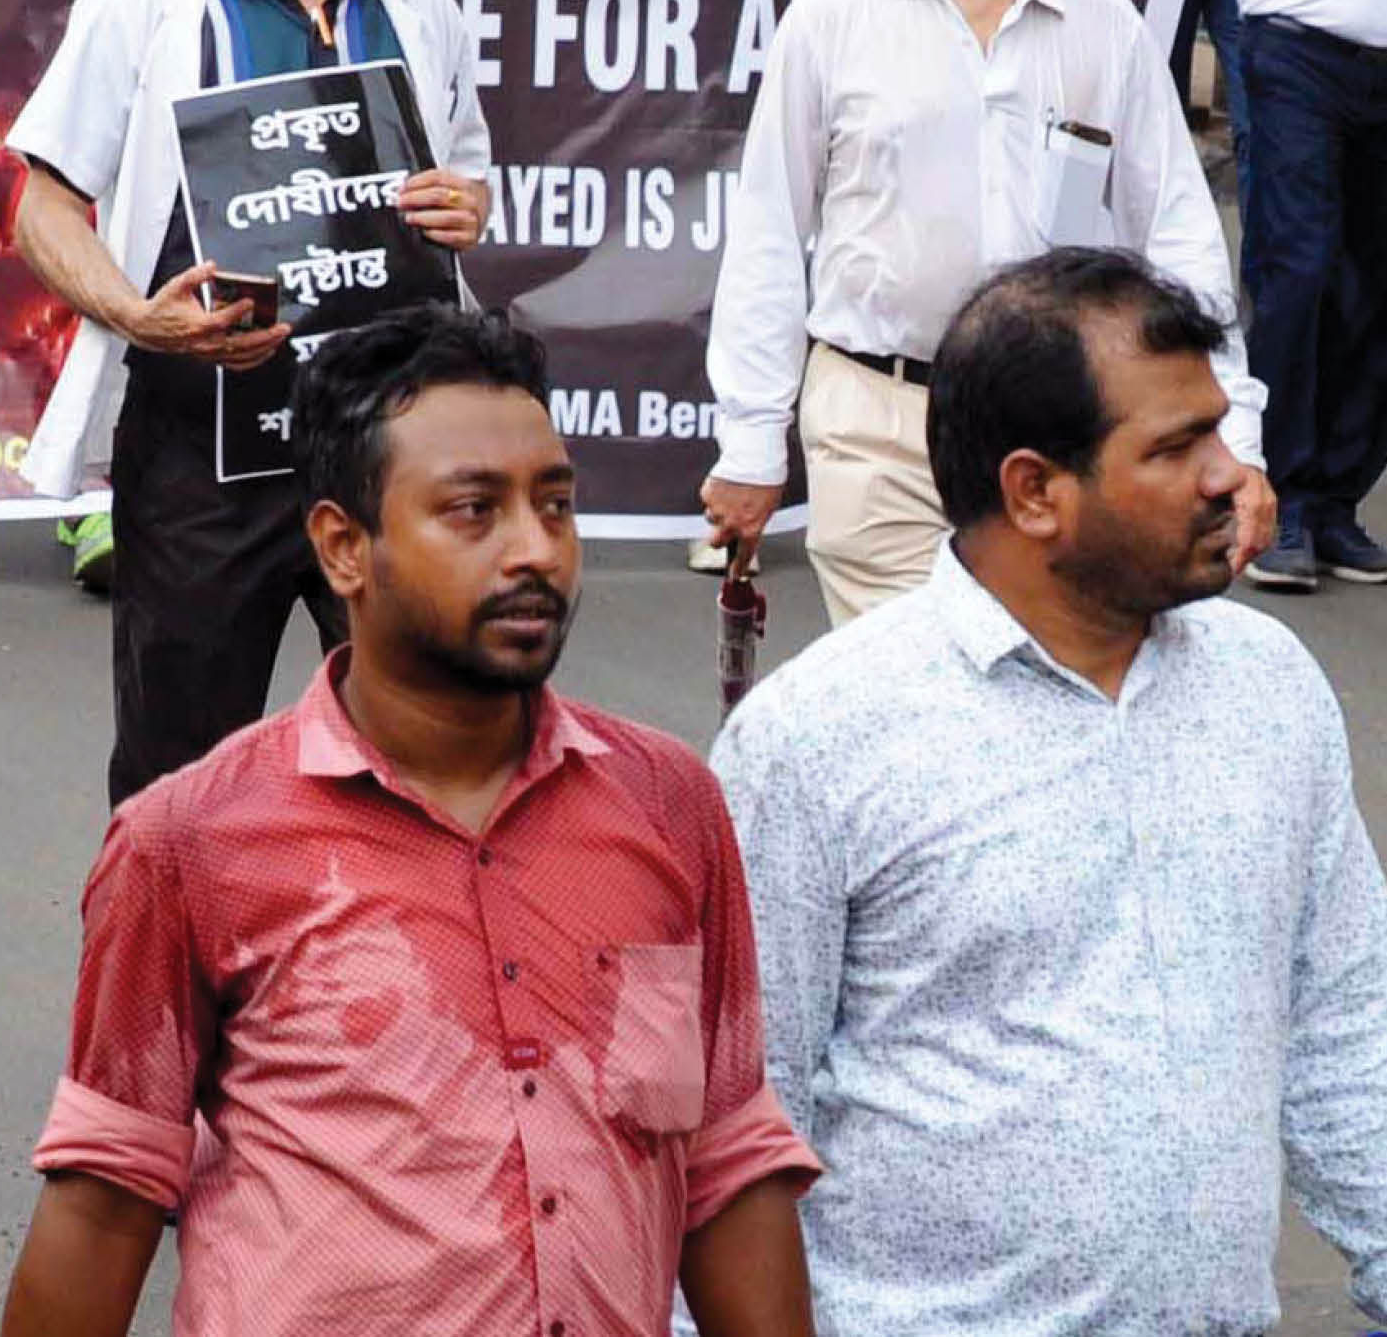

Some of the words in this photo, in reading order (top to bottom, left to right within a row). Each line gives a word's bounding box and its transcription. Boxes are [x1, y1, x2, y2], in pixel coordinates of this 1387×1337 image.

[250, 102, 361, 153] প্রকৃত
[626, 168, 675, 251] IS
[277, 244, 387, 306] দৃষ্টান্ত
